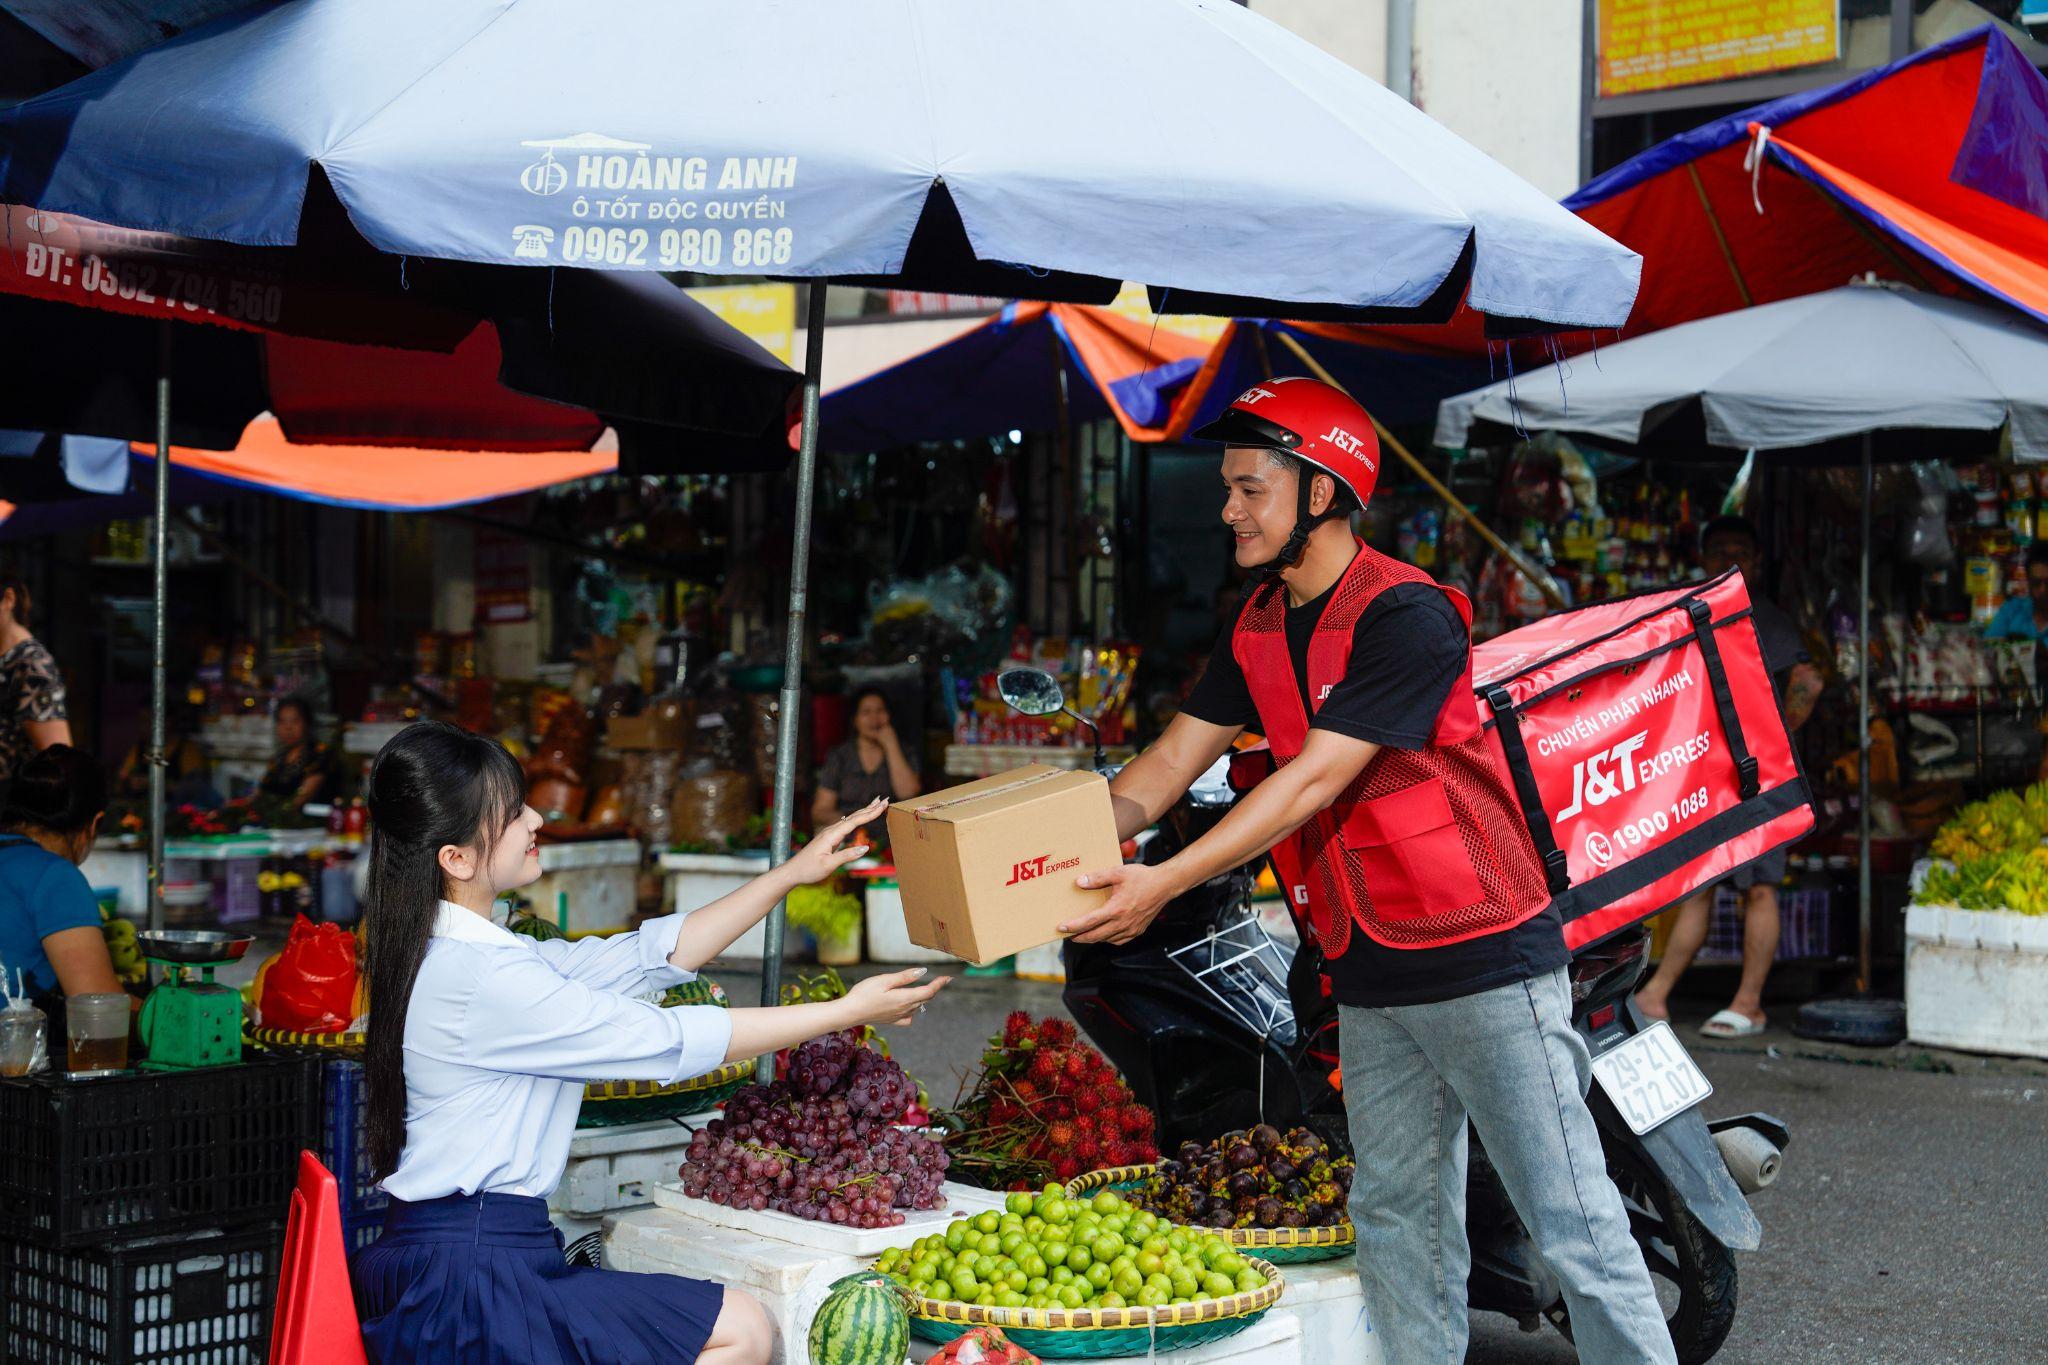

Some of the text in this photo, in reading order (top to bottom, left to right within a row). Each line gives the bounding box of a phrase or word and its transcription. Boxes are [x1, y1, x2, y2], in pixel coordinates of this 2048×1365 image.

[576, 150, 797, 190] HOÀNG ANH
[572, 194, 785, 222] Ô TỐT ĐỘC QUYỀN
[562, 226, 793, 267] 0962 980 868
[25, 242, 72, 286] ĐT:
[81, 255, 156, 304] 0362
[165, 268, 220, 315] 794
[226, 280, 282, 323] 560
[1319, 426, 1376, 473] J&T EXPRESS
[1537, 669, 1694, 757] CHUYỂN PHÁT NHANH
[1555, 729, 1710, 824] J&T EXPRESS
[1612, 786, 1709, 850] 1900 1088
[1005, 854, 1080, 887] J&T EXPRESS
[1597, 1031, 1624, 1047] HONDA
[1622, 1061, 1699, 1125] 472.07
